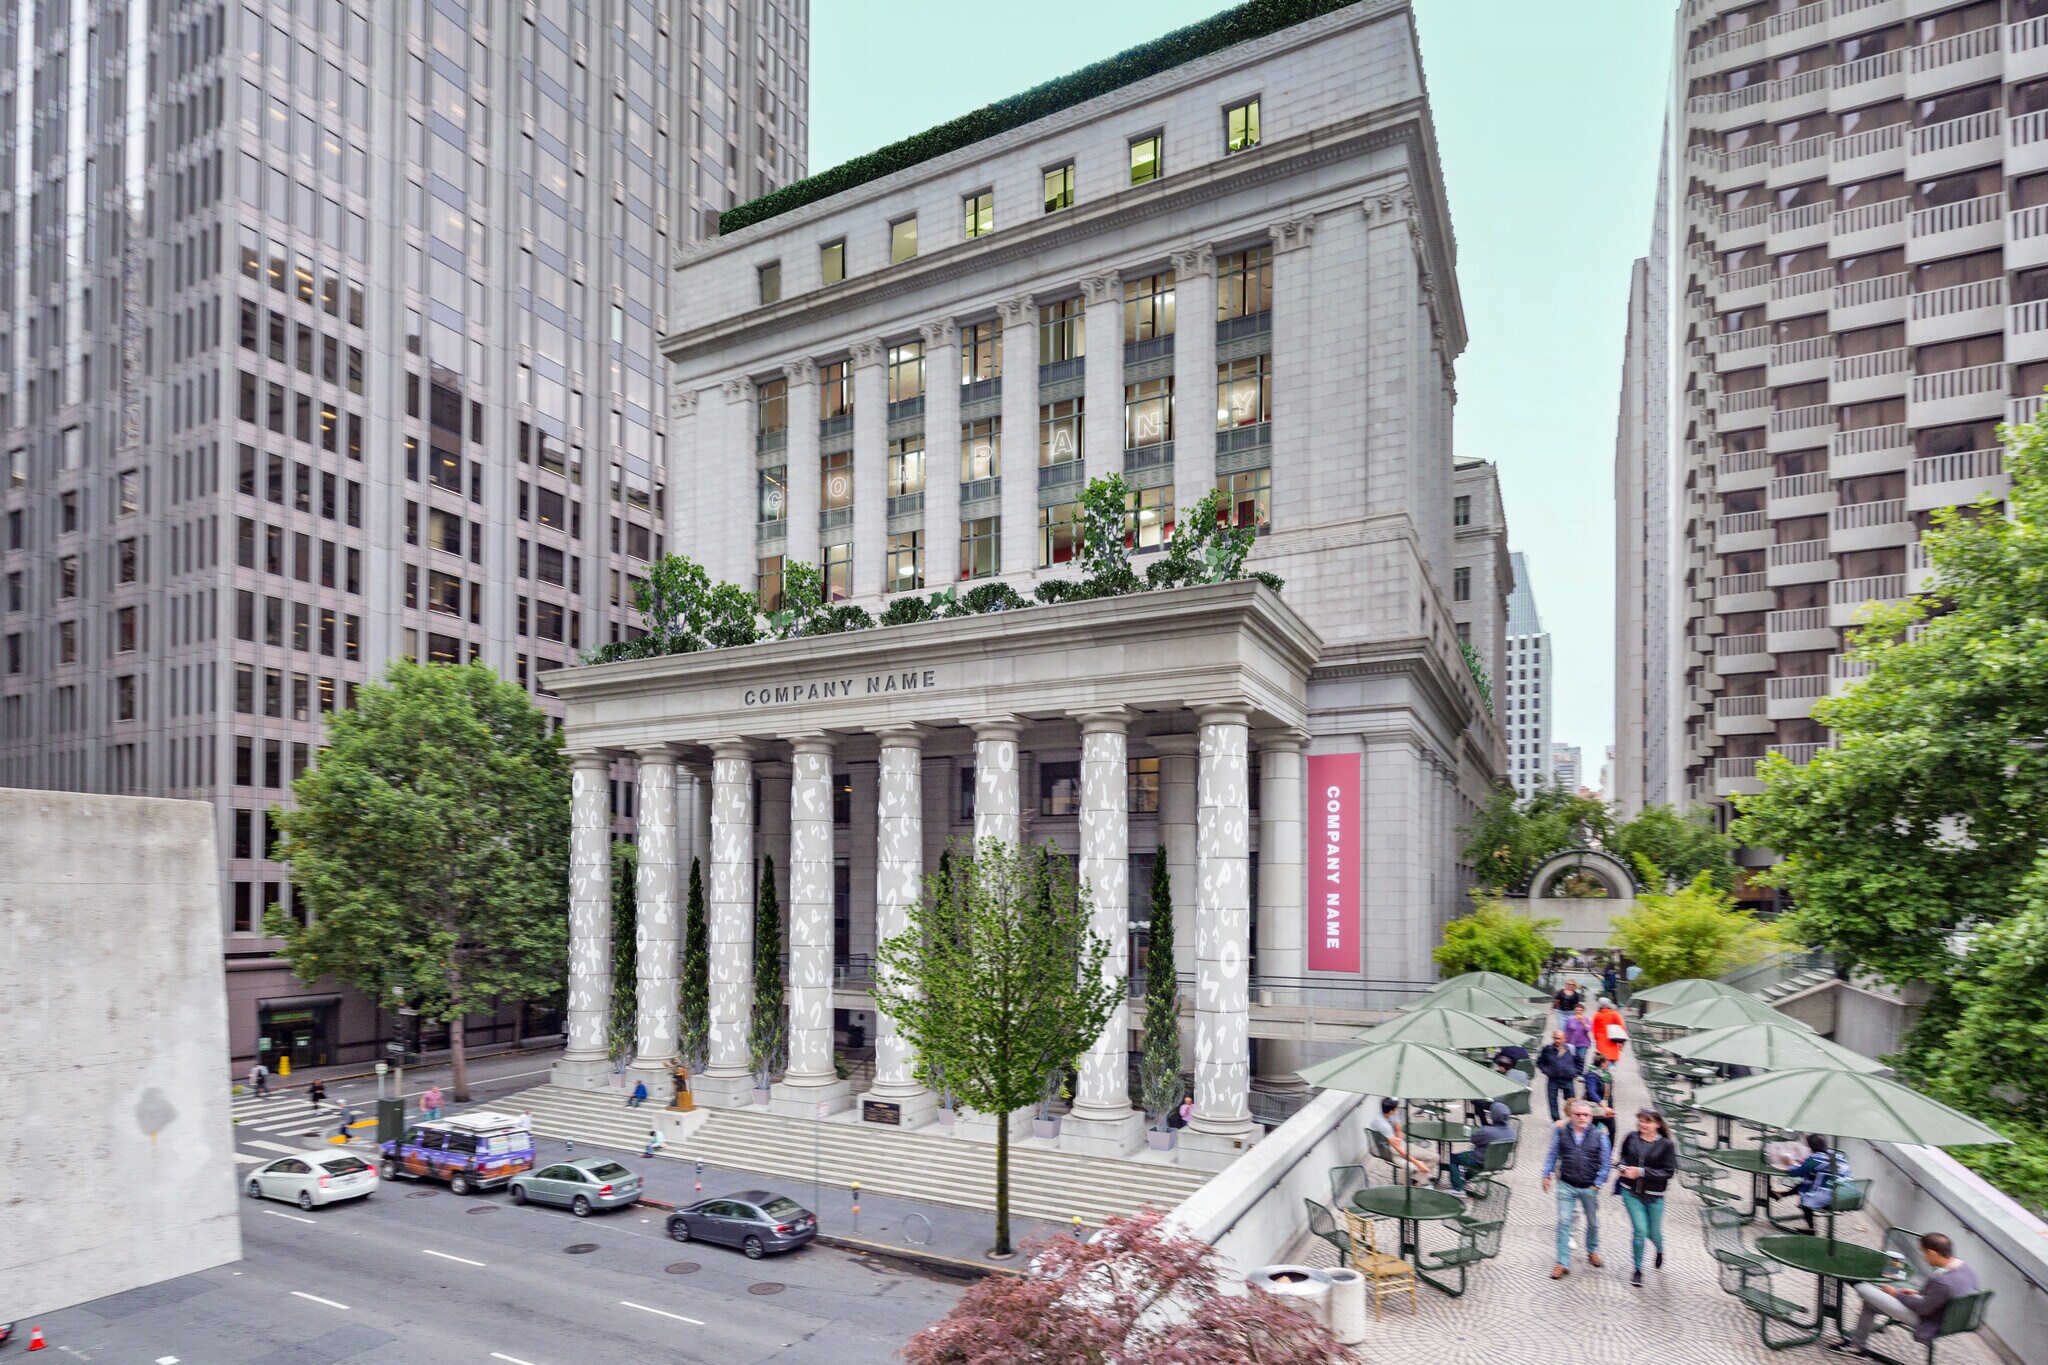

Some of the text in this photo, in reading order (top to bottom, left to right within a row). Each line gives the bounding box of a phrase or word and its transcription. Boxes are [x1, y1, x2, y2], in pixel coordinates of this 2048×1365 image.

[744, 670, 935, 706] COMPANY NAME
[1326, 785, 1340, 949] COMPANY NAME
